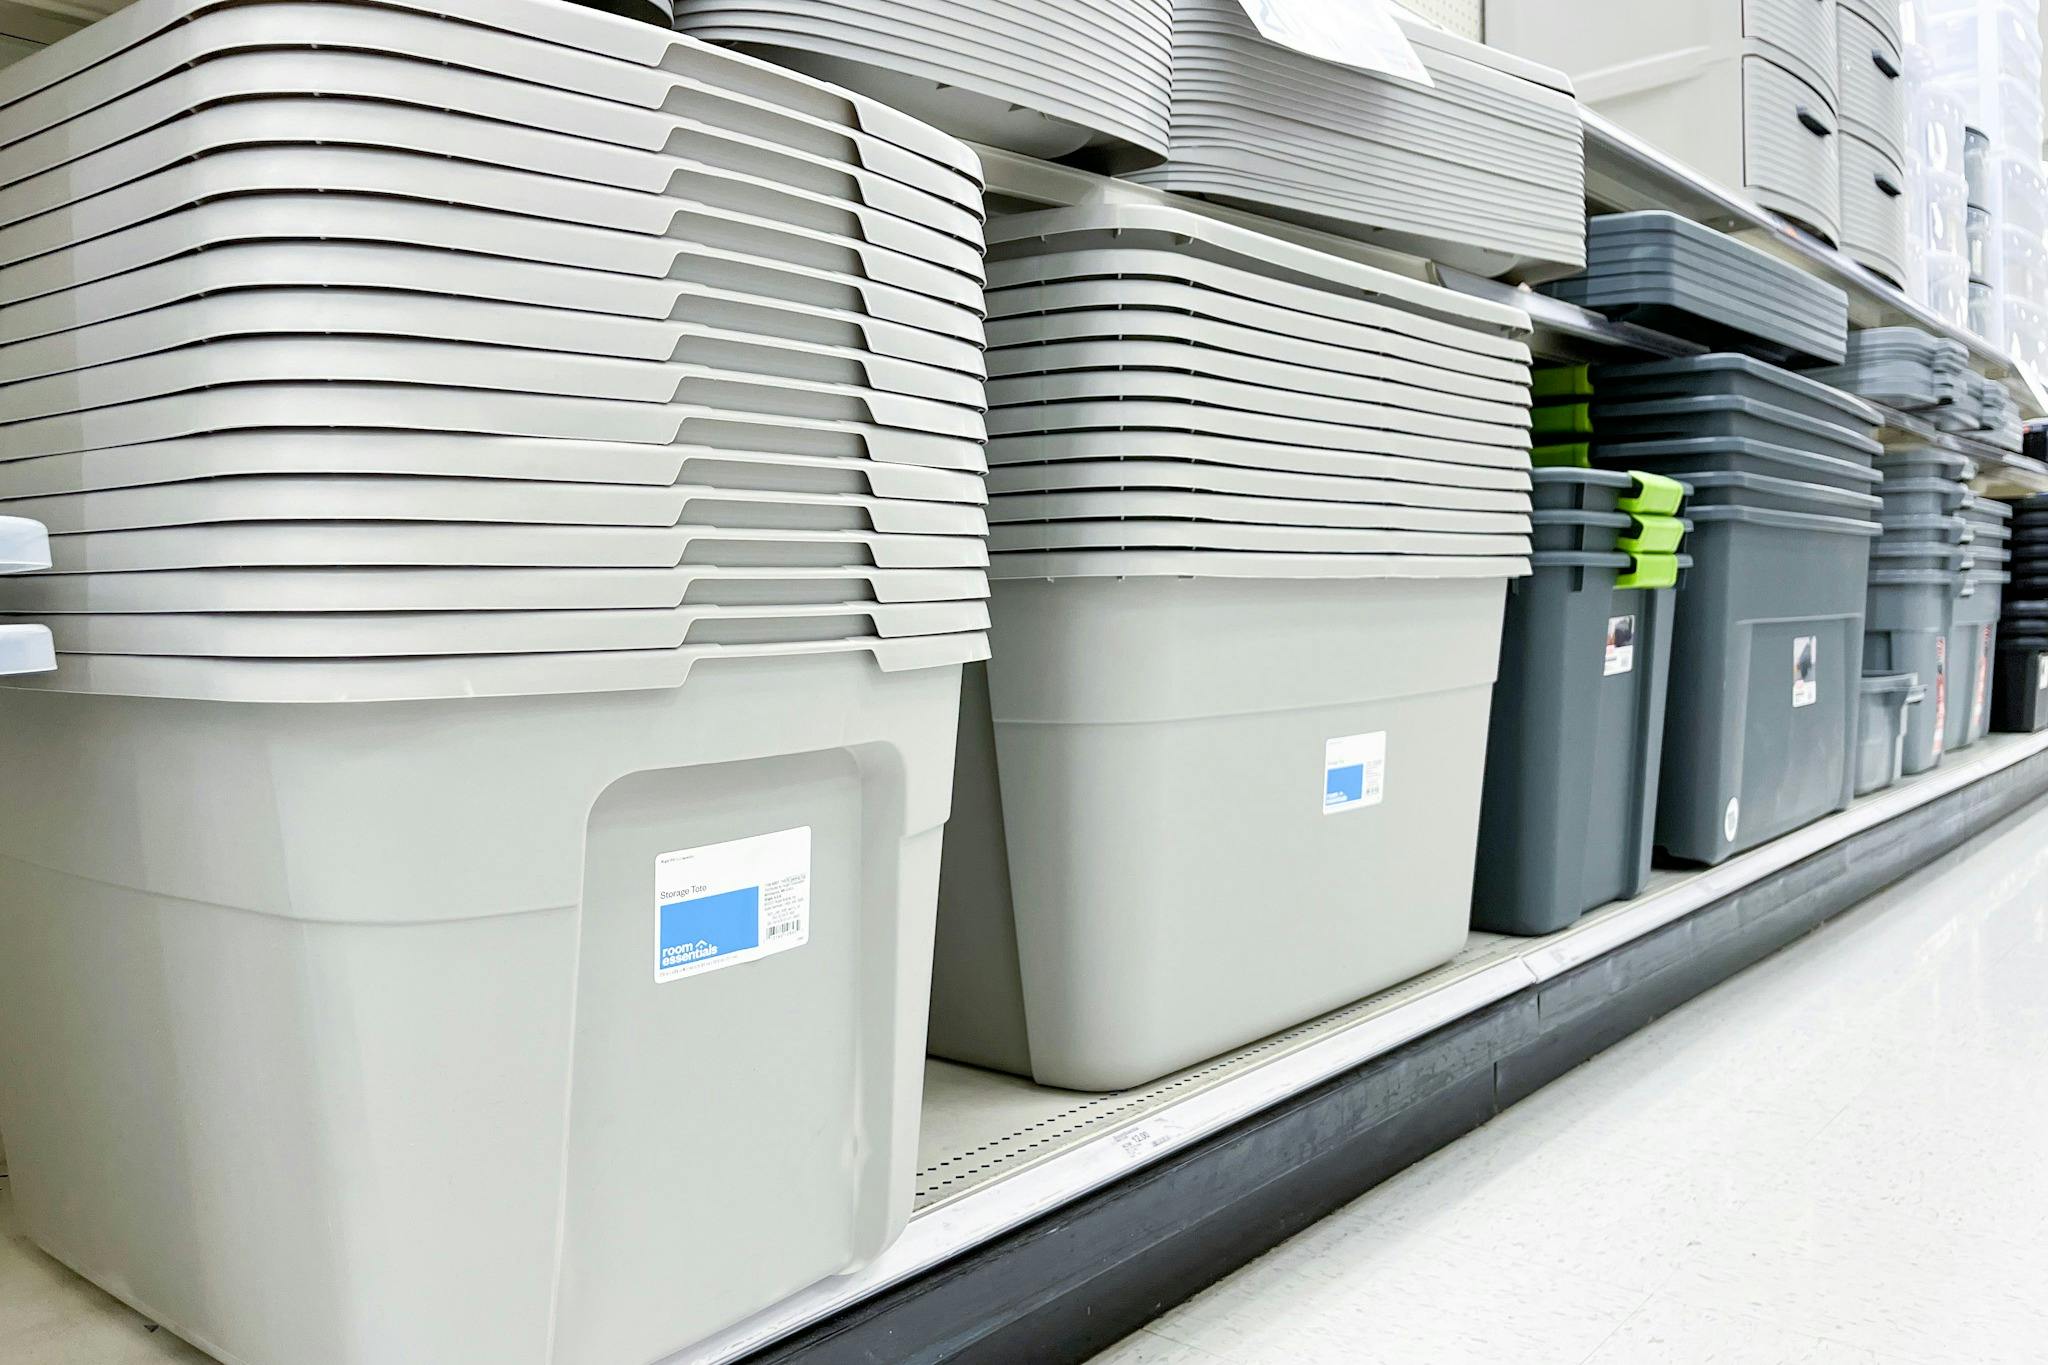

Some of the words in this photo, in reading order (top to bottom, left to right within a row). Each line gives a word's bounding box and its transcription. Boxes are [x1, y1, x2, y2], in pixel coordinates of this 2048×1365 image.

[660, 888, 690, 900] Storage
[691, 885, 707, 894] Tote
[662, 942, 693, 957] room
[662, 943, 718, 966] essentials
